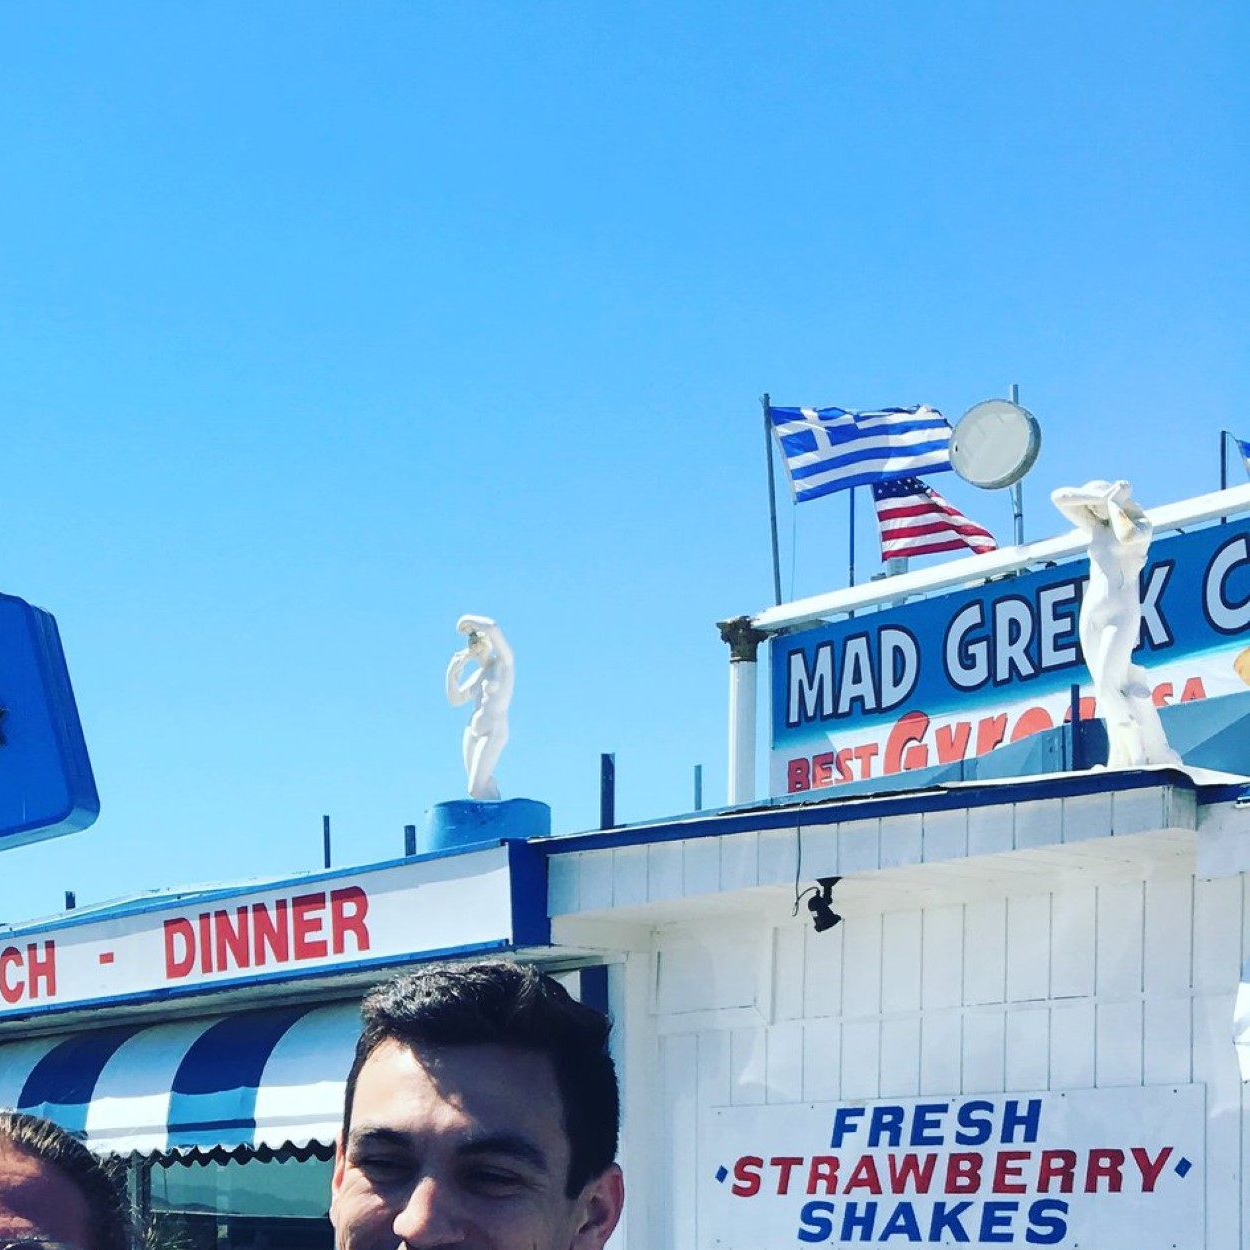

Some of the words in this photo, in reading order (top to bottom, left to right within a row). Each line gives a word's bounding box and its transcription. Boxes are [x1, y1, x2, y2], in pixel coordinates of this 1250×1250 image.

[786, 626, 919, 727] MAD
[945, 559, 1175, 691] GREK
[787, 743, 879, 793] BEST
[163, 885, 370, 979] DINNER
[830, 1098, 1043, 1149] FRESH
[731, 1146, 1174, 1198] STRAWBERRY
[797, 1198, 1070, 1245] SHAKES
